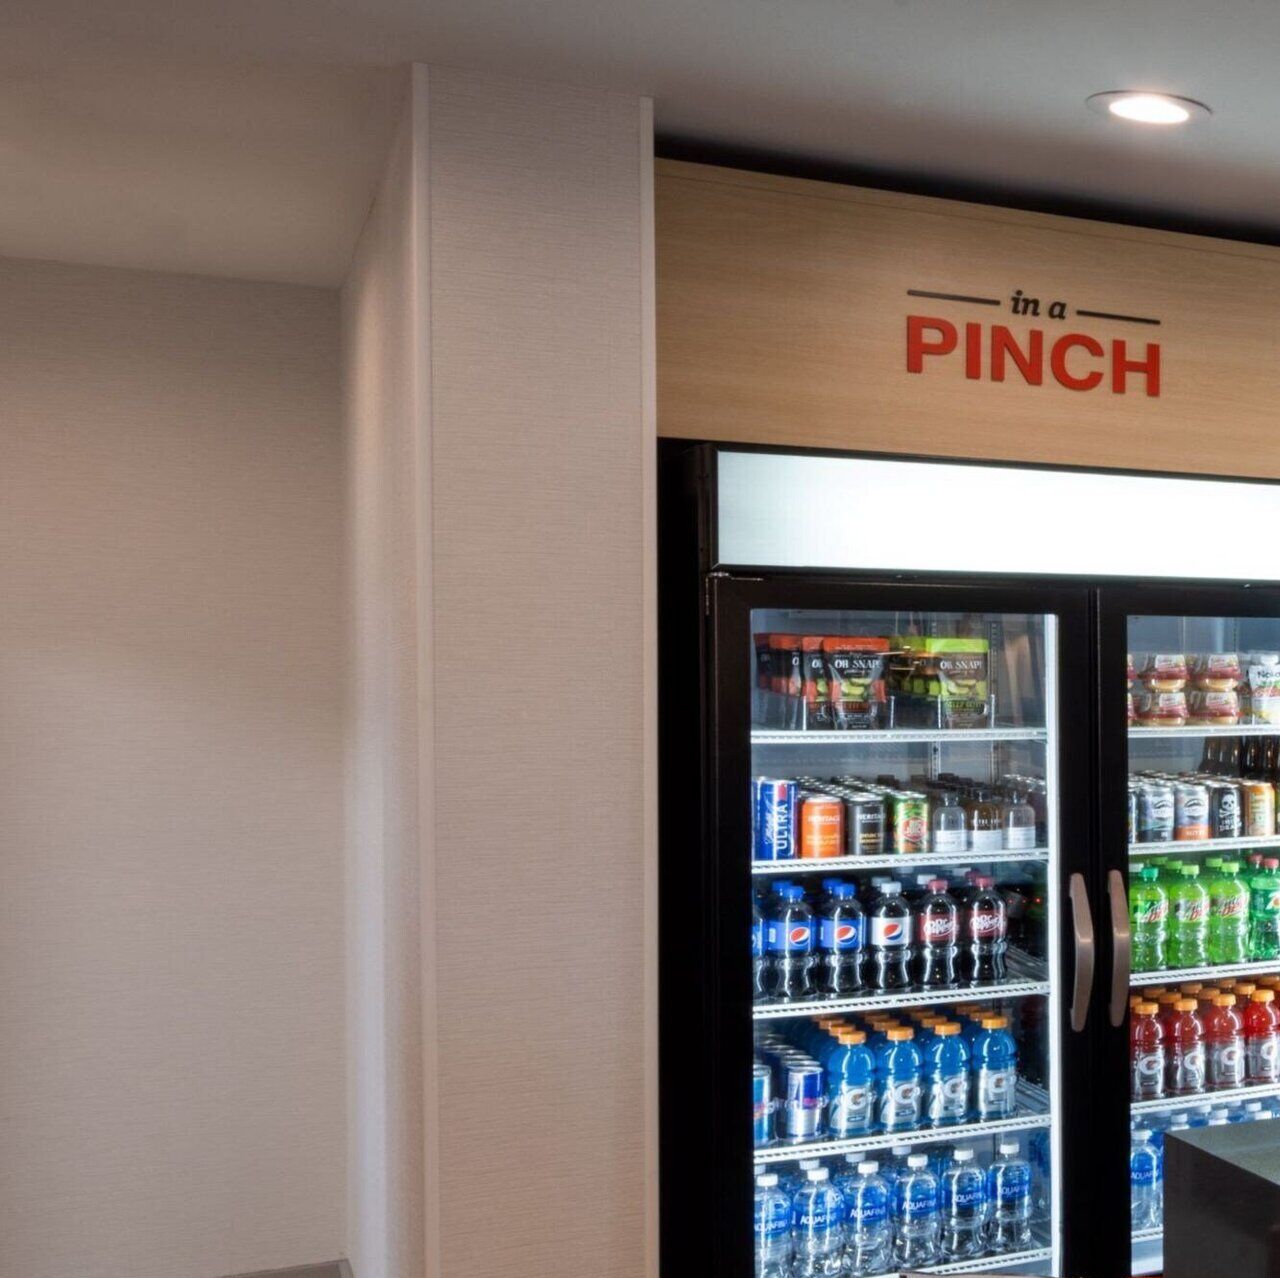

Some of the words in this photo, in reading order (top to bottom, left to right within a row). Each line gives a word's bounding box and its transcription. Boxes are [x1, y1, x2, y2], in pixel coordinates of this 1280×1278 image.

[1011, 290, 1040, 317] in
[1048, 299, 1067, 320] a
[907, 315, 1160, 397] PINCH
[777, 803, 788, 850] ULTRA
